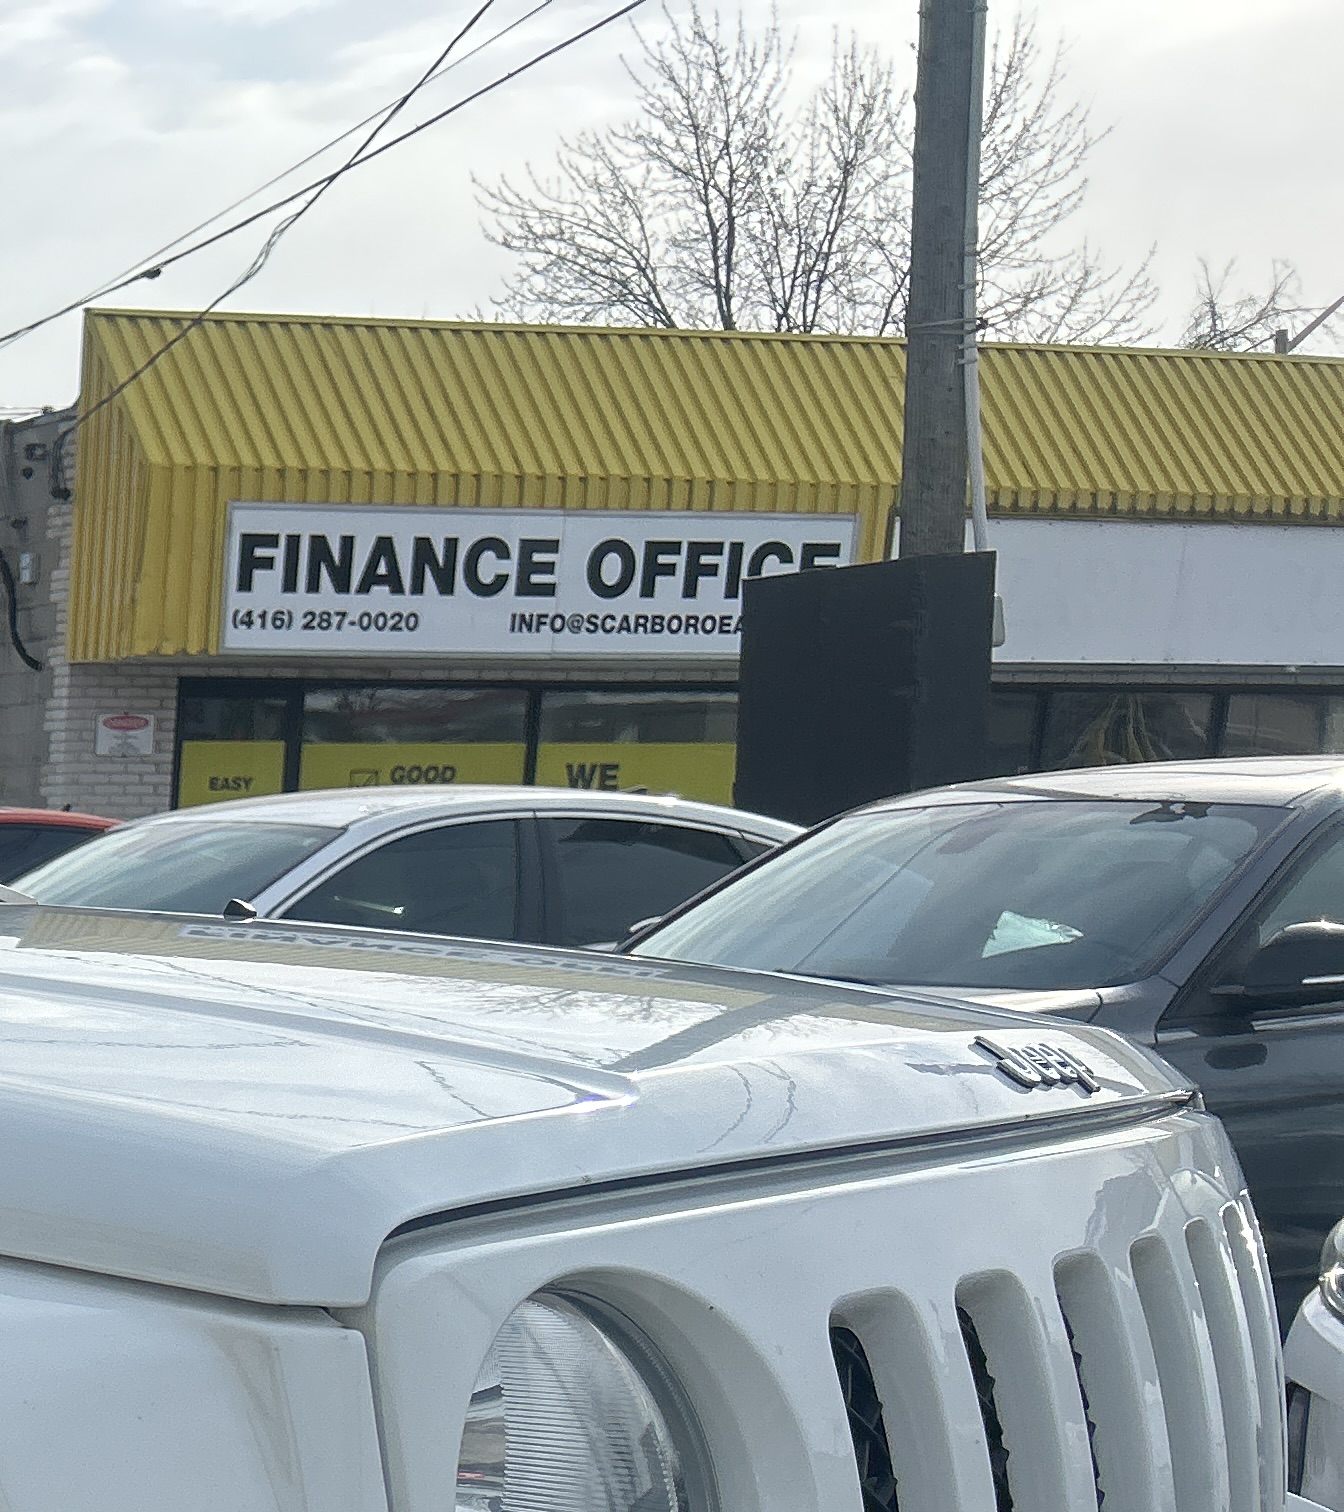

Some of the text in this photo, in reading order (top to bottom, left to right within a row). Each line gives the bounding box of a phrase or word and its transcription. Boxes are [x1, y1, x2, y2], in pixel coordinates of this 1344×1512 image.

[237, 533, 560, 598] FINANCE
[231, 609, 294, 631] (416)
[301, 611, 420, 632] 287-0020
[208, 776, 254, 792] EASY
[390, 765, 457, 784] GOOD
[566, 762, 619, 791] WE
